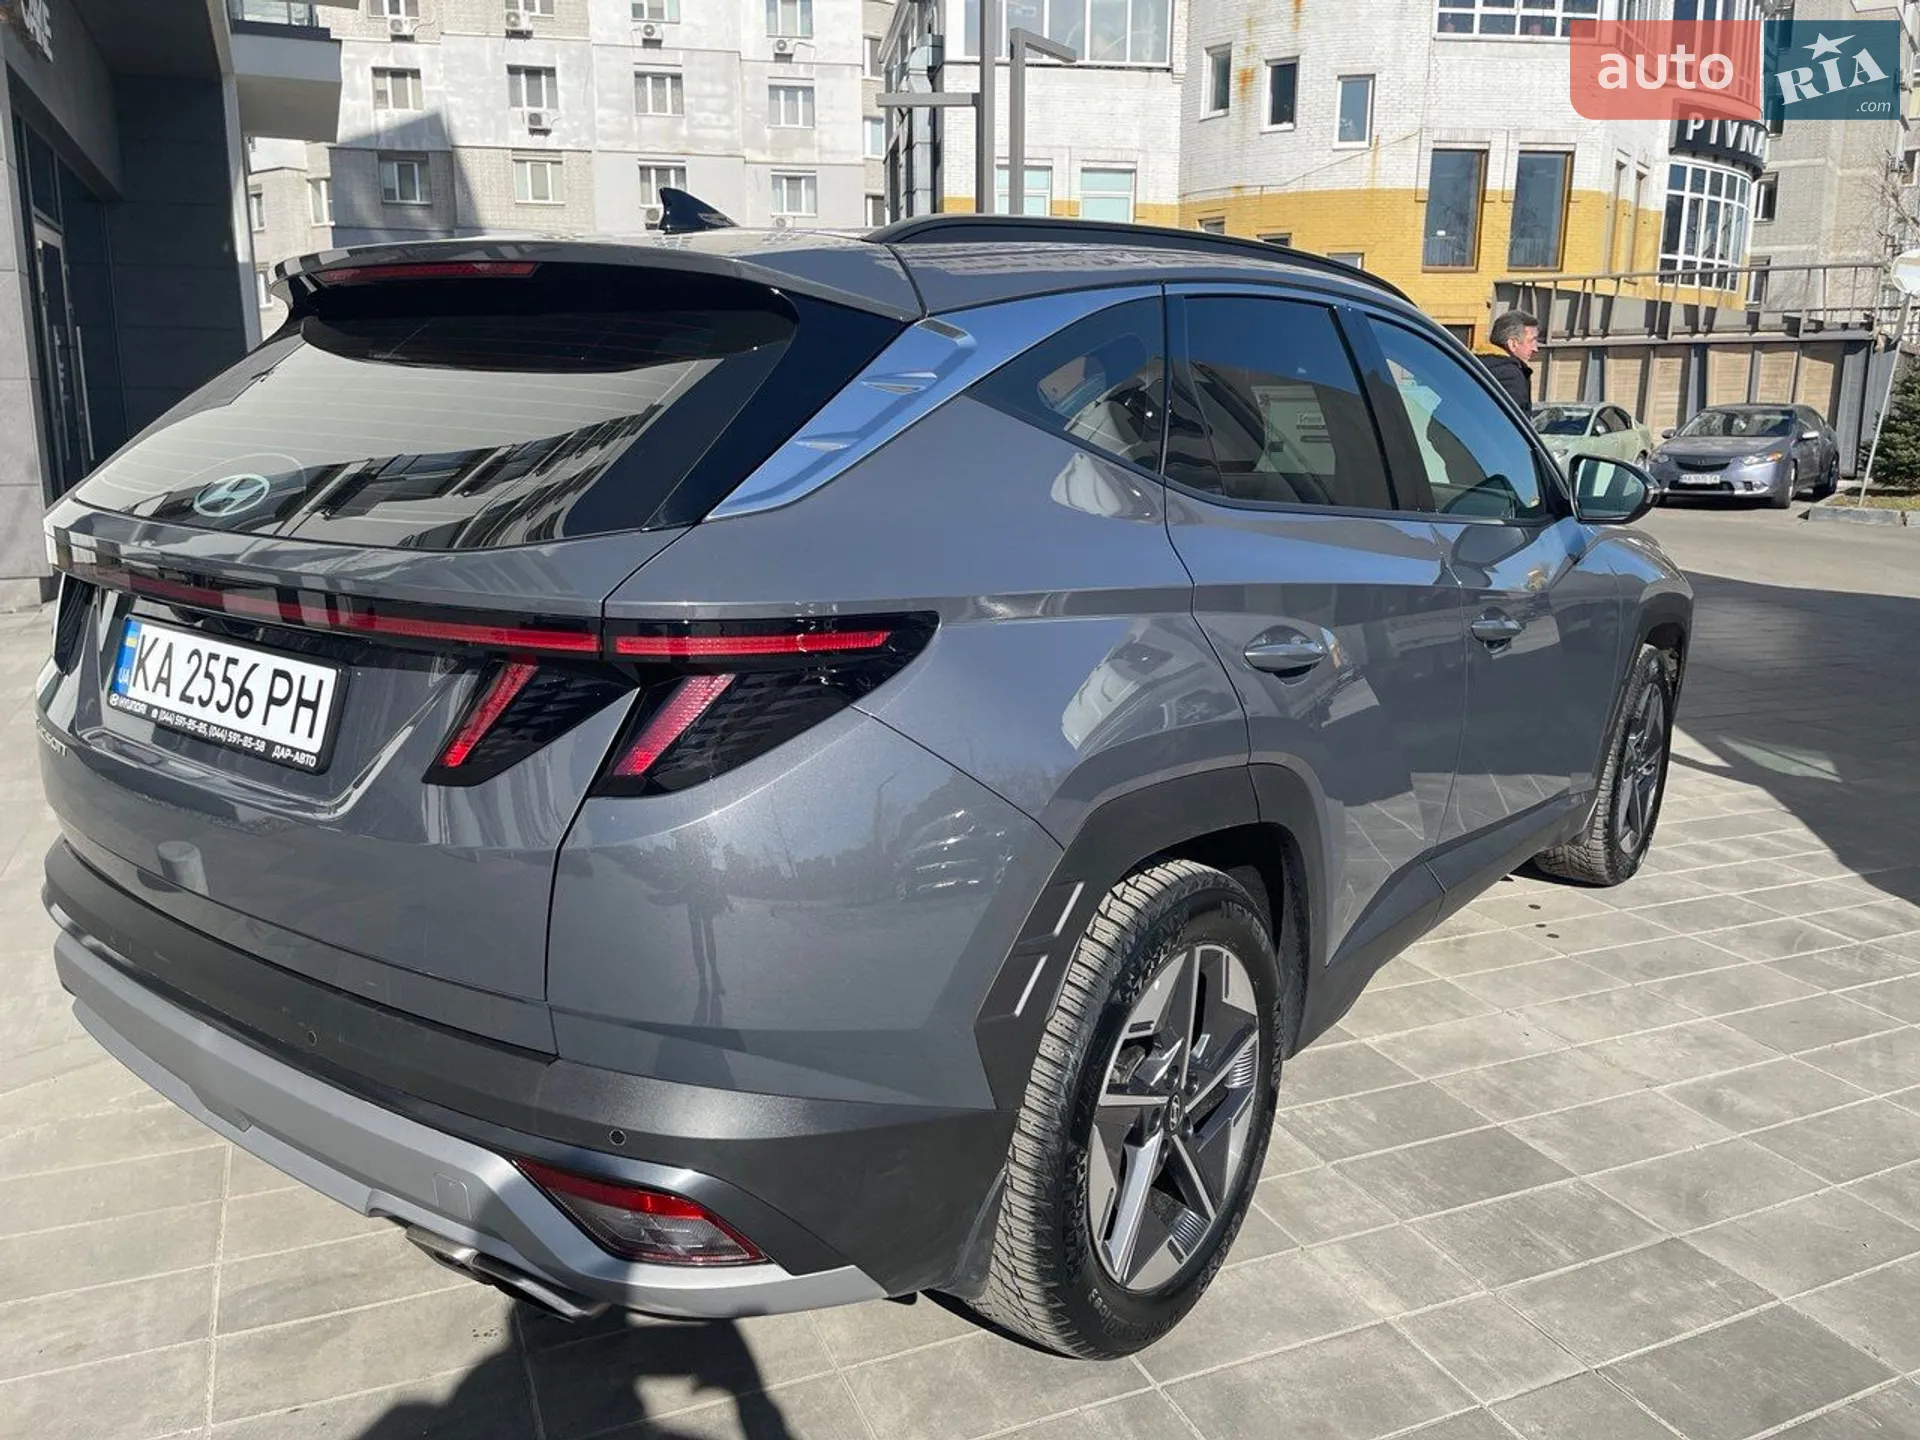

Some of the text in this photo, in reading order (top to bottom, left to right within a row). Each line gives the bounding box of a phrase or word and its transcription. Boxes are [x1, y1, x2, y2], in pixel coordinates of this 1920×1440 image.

[118, 667, 129, 685] UA
[131, 634, 324, 739] KA 2556 PH
[272, 745, 316, 767] ДАР-АВТО
